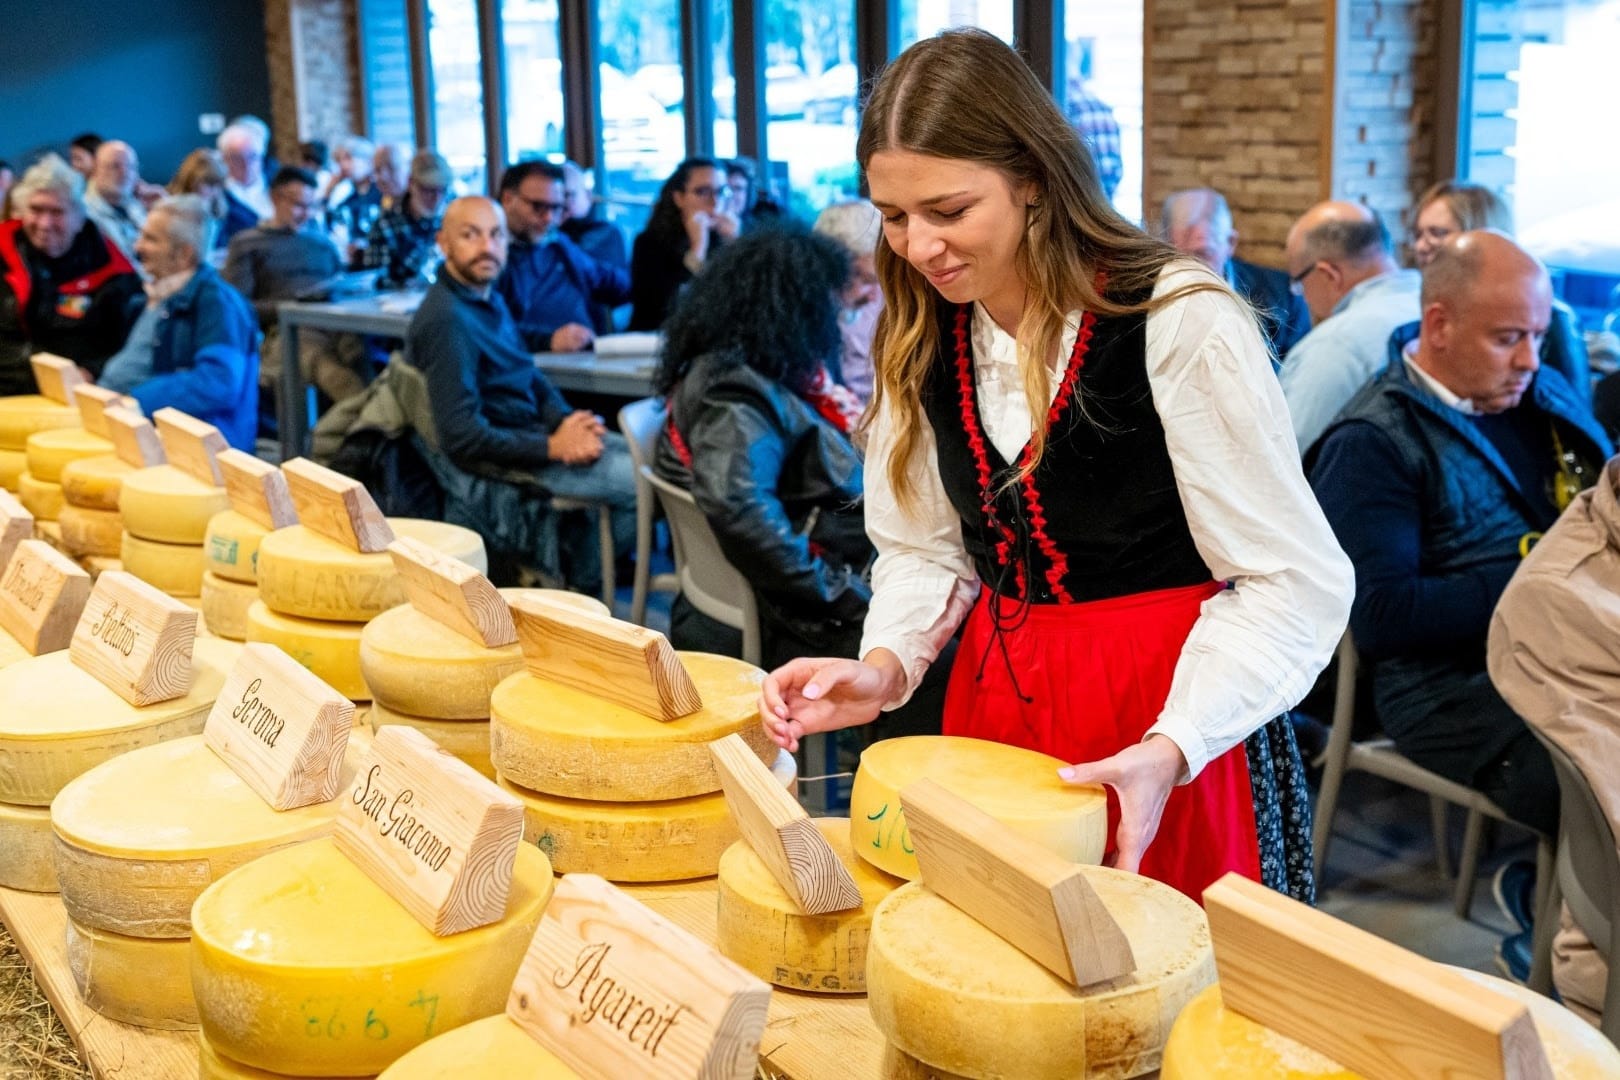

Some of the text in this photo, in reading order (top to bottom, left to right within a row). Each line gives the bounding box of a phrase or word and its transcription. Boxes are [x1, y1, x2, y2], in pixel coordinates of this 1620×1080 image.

[232, 678, 285, 749] Gerona
[352, 764, 452, 872] San Giacomo
